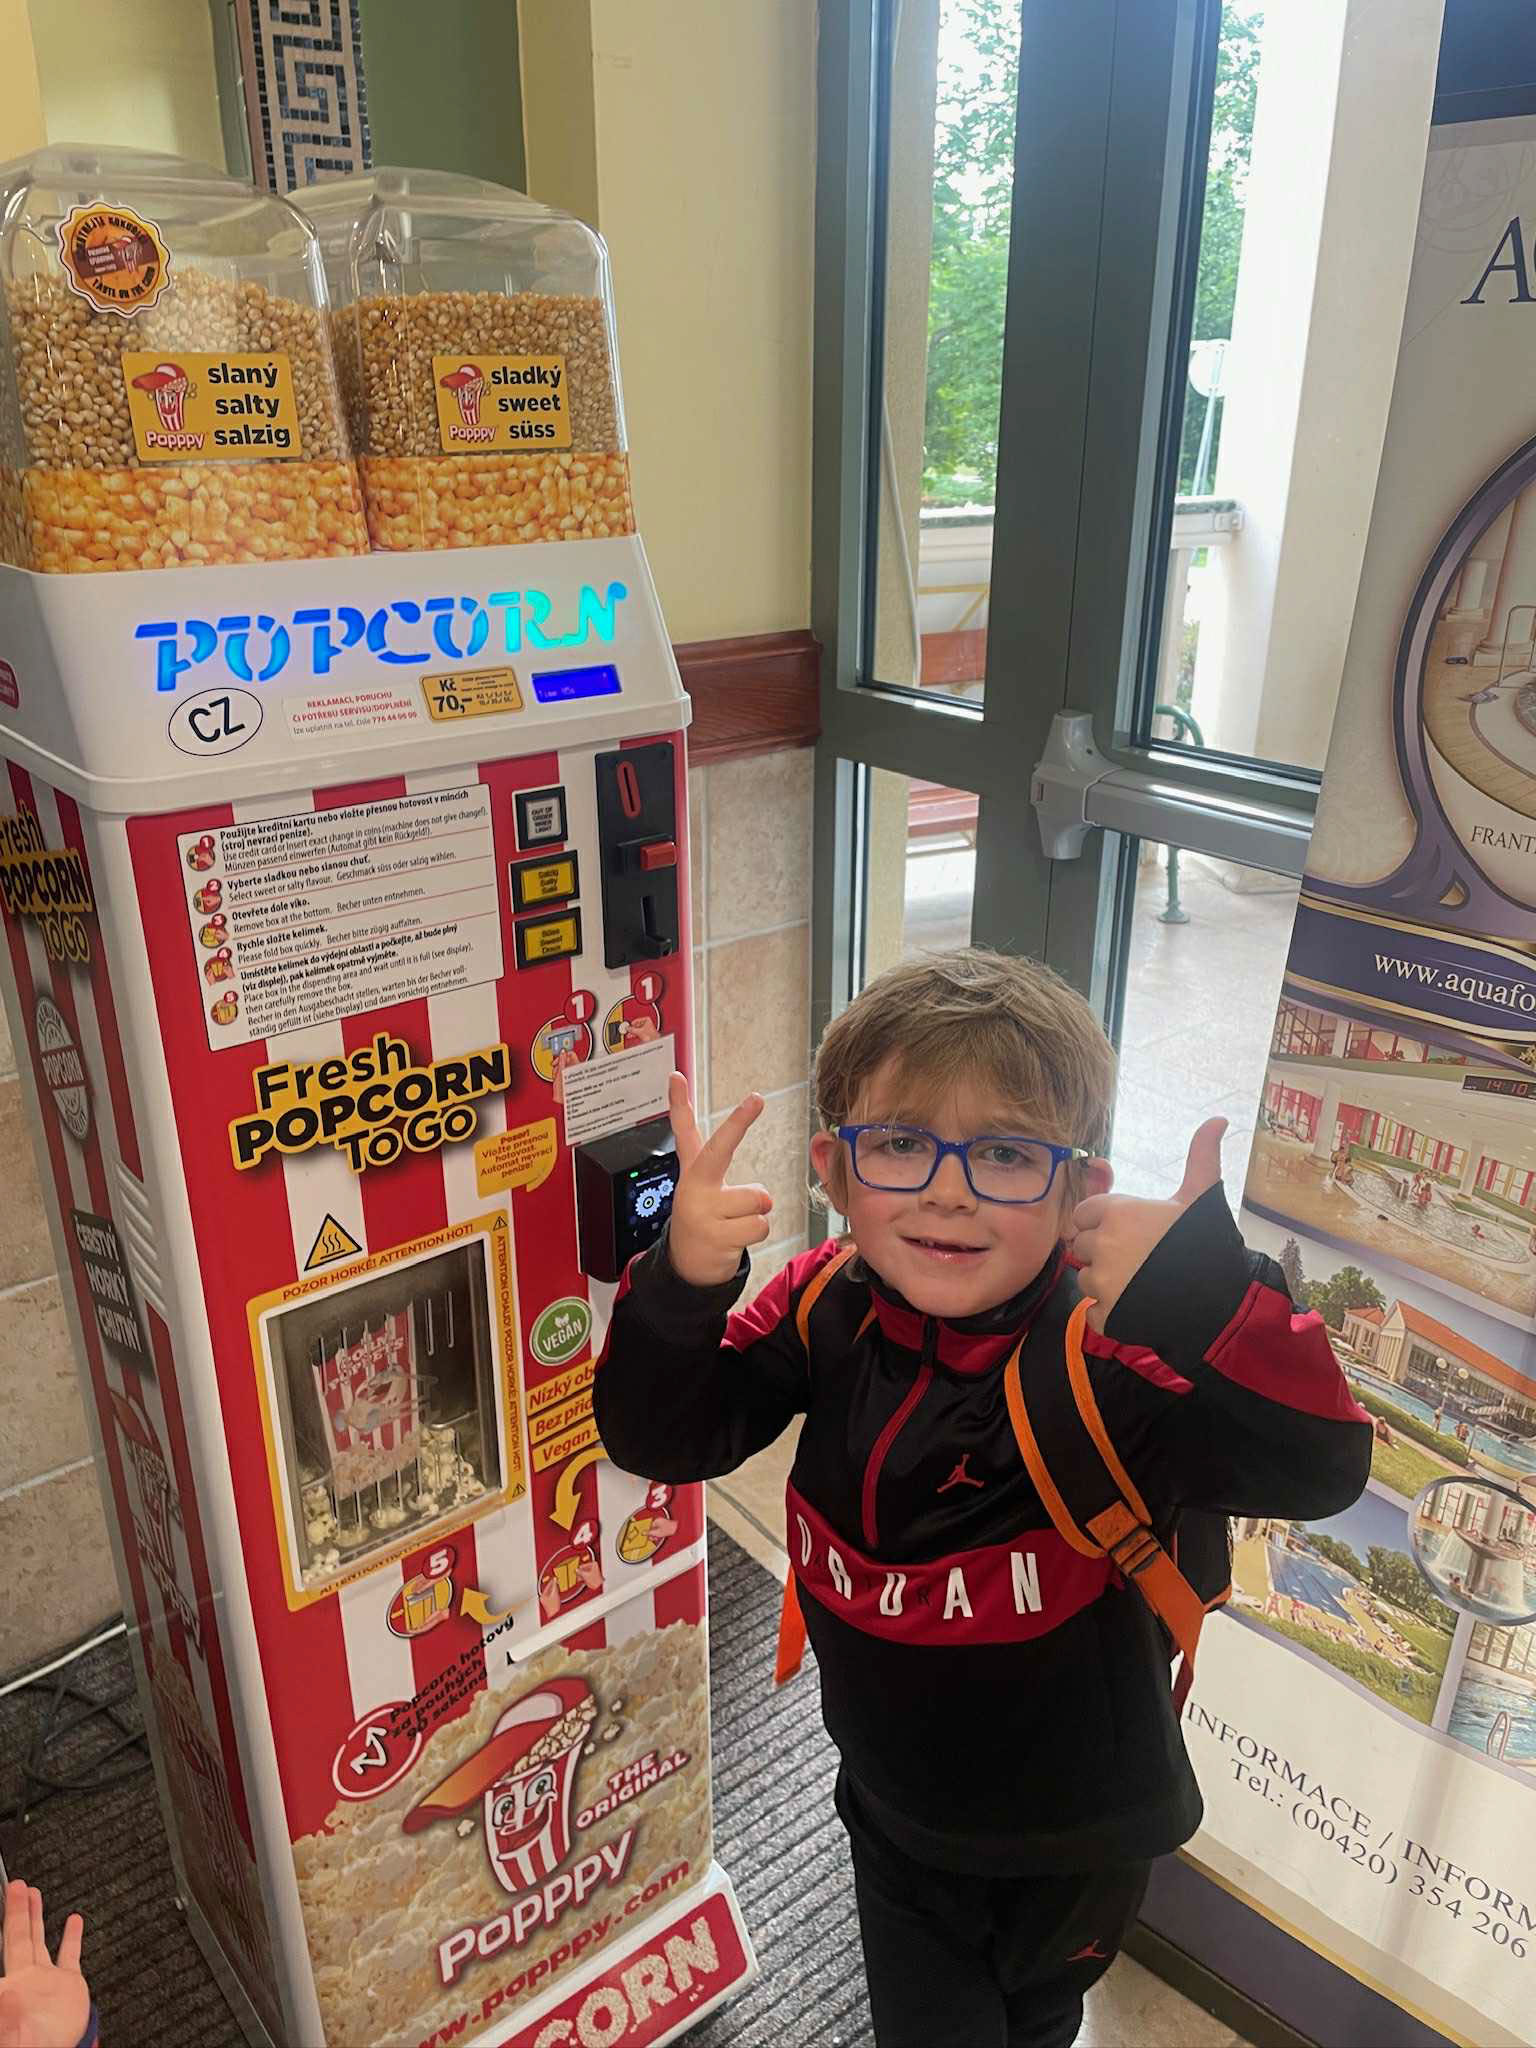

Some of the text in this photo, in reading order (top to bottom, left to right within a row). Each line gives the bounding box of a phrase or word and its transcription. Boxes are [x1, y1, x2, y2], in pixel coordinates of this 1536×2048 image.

[1460, 216, 1536, 304] A
[208, 362, 278, 388] slaný
[491, 365, 561, 388] sladký
[216, 394, 280, 418] salty
[498, 394, 561, 412] sweet
[214, 424, 291, 448] salzig
[509, 420, 556, 439] süss
[136, 581, 628, 692] POPCORN
[440, 677, 457, 692] Kč
[187, 695, 247, 744] CZ
[219, 825, 256, 841] Použijte
[257, 819, 291, 833] kreditní
[293, 815, 315, 827] kartu
[317, 812, 338, 823] nebo
[339, 807, 364, 819] vložte
[365, 801, 397, 817] přesnou
[398, 795, 432, 809] hotovost
[439, 790, 468, 802] mincích
[1471, 825, 1536, 854] FRANT
[0, 855, 90, 908] POPCORN
[227, 875, 262, 891] Vyberte
[263, 868, 296, 883] sladkou
[298, 864, 319, 876] nebo
[320, 858, 347, 871] slanou
[231, 904, 268, 921] Otevřete
[269, 900, 288, 913] dole
[265, 916, 278, 927] box
[289, 910, 302, 921] the
[236, 922, 327, 953] Rychle složte kelímek.
[237, 950, 262, 963] Please
[279, 942, 292, 954] box
[277, 956, 308, 972] kelímek
[309, 954, 319, 964] do
[320, 947, 348, 963] výdejní
[375, 941, 379, 949] a
[423, 926, 441, 938] bude
[289, 970, 303, 982] pak
[304, 962, 334, 977] kelímek
[245, 1002, 262, 1014] then
[296, 988, 322, 1001] remove
[324, 984, 336, 995] the
[641, 976, 654, 1001] 1
[571, 994, 585, 1020] 1
[257, 1036, 407, 1110] Fresh
[236, 1049, 506, 1163] POPCORN
[338, 1107, 474, 1171] TO GO
[283, 1223, 474, 1300] POZOR HORKÉ! ATTENTION HOT!
[496, 1235, 509, 1290] ATTENTION
[85, 1260, 129, 1307] HORKÝ
[543, 1318, 583, 1353] VEGAN
[530, 1375, 572, 1409] Nízký
[535, 1411, 562, 1436] Bez
[543, 1430, 591, 1462] Vegan
[651, 1484, 668, 1508] 3
[573, 1522, 594, 1545] 4
[430, 1549, 448, 1575] 5
[460, 1615, 515, 1664] hotový
[610, 1751, 659, 1790] THE
[1186, 1701, 1374, 1838] INFORMACE
[577, 1754, 689, 1828] ORIGINAL
[1231, 1757, 1528, 1960] Tel.: (00420) 354 206
